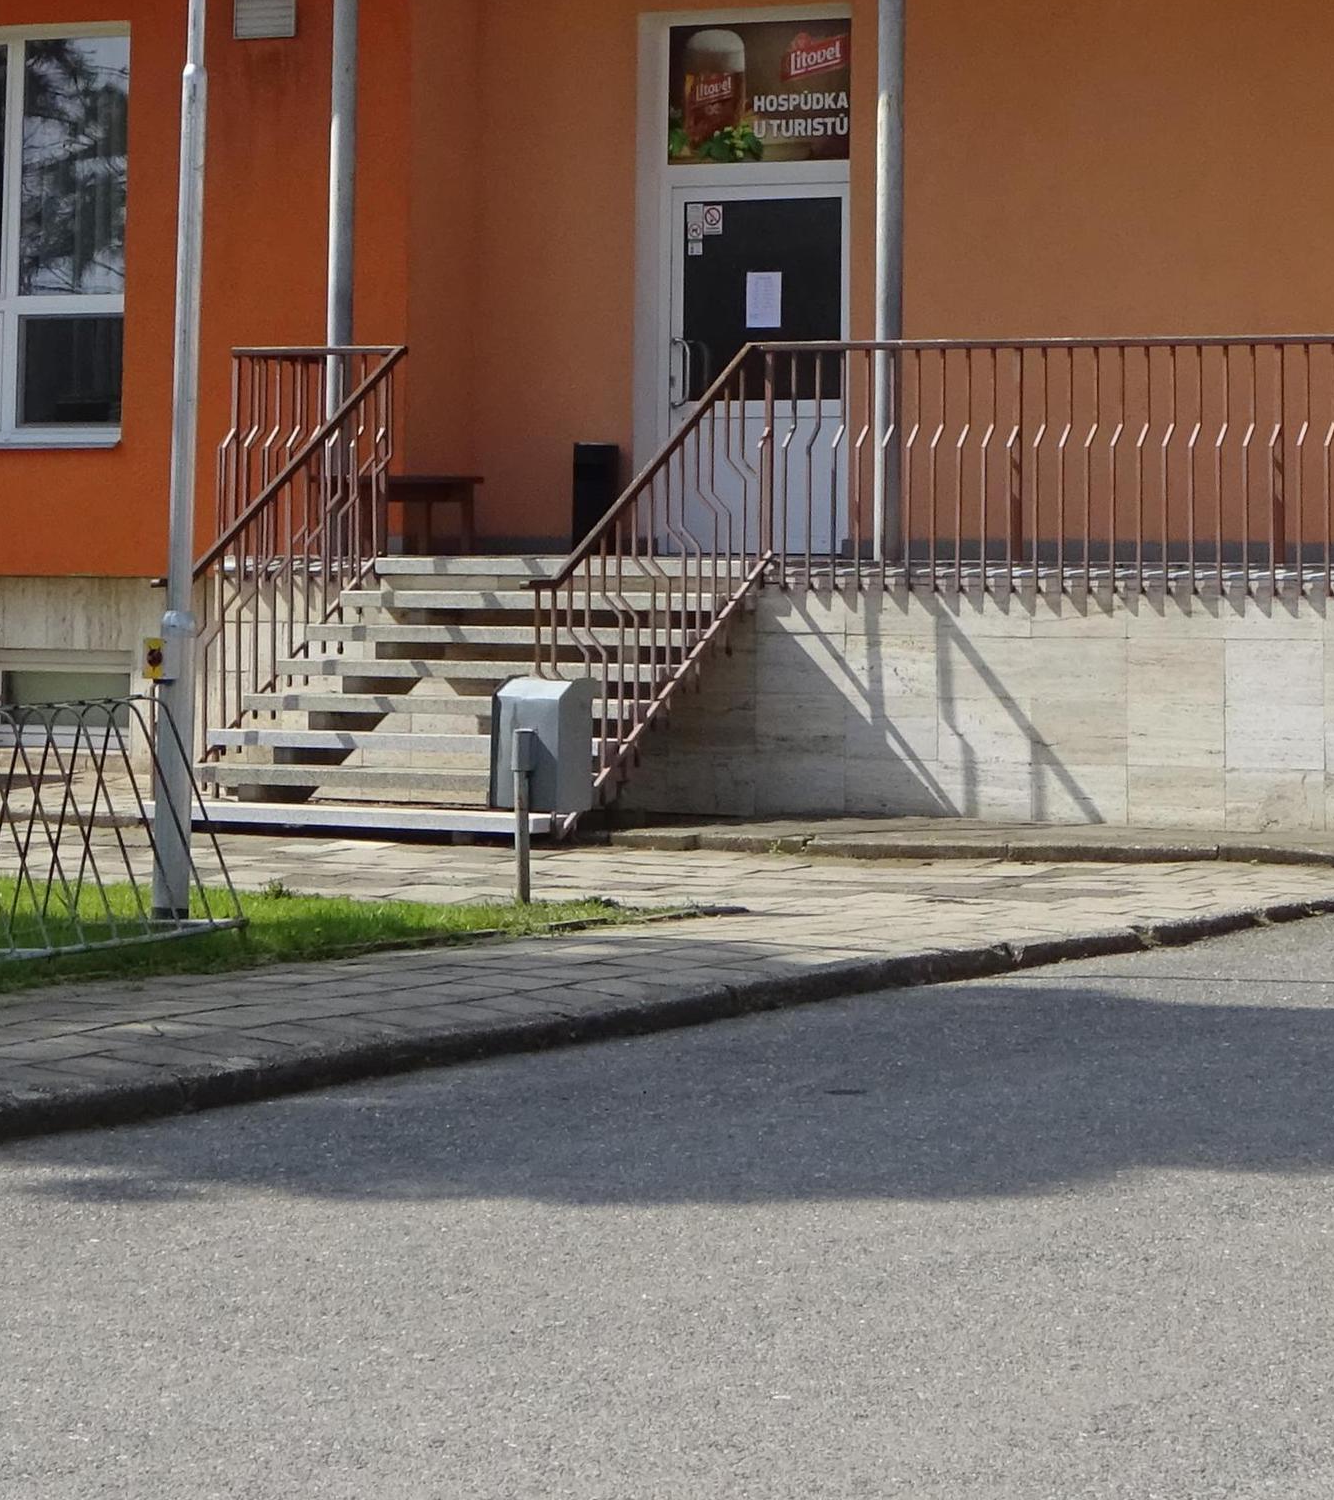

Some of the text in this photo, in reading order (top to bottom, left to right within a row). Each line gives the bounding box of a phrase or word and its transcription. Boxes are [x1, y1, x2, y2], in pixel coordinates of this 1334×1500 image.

[789, 40, 842, 76] Litovel
[695, 75, 732, 101] Litovel
[753, 90, 849, 112] HOSPŮDKA
[753, 113, 849, 138] U TURISTŮ
